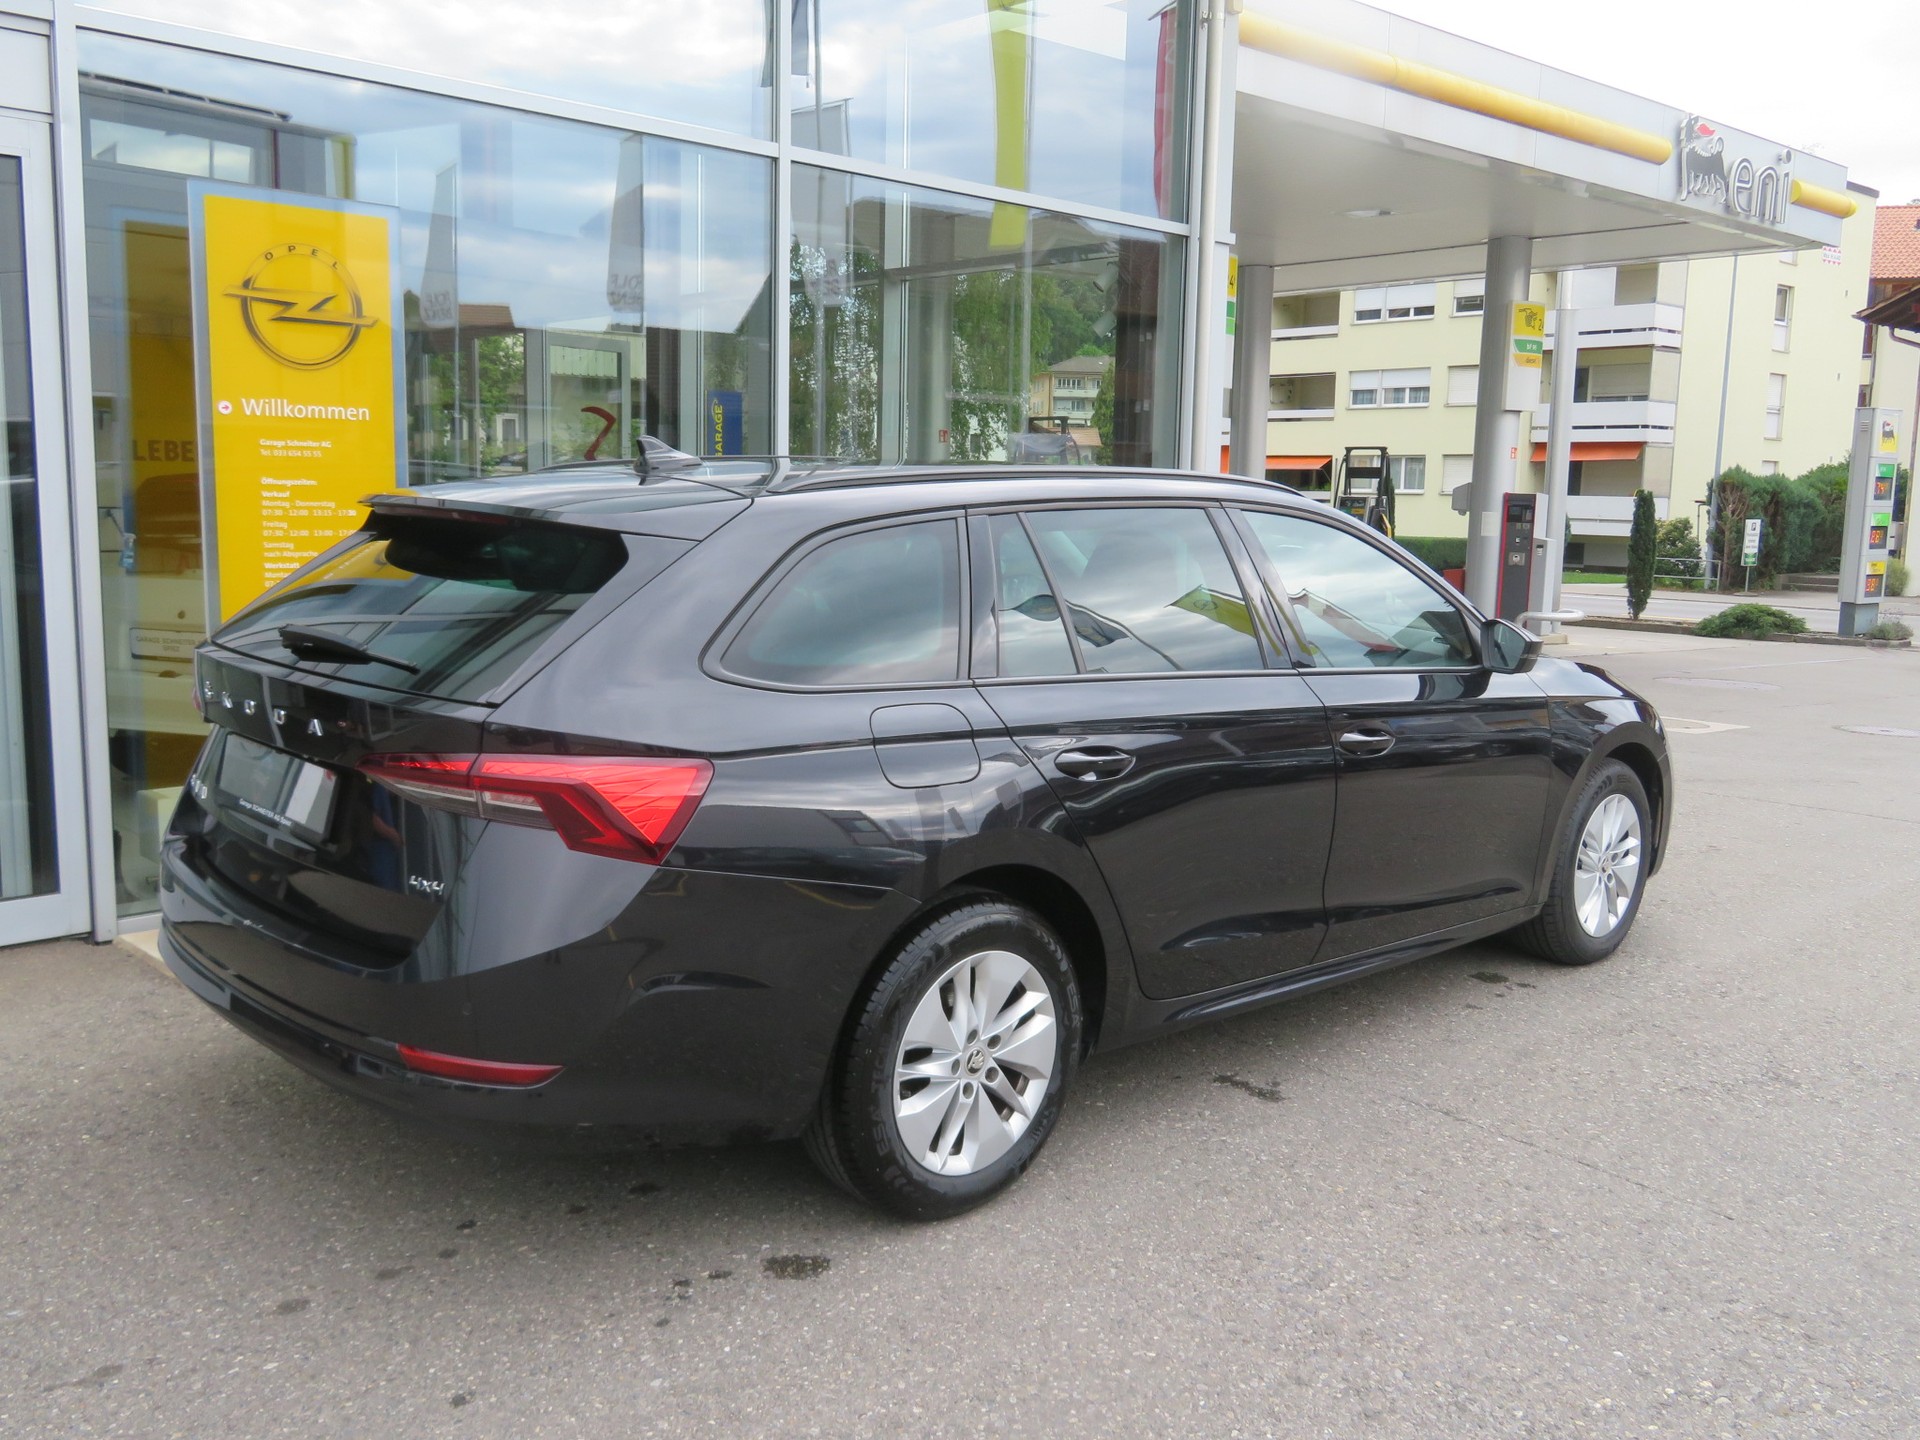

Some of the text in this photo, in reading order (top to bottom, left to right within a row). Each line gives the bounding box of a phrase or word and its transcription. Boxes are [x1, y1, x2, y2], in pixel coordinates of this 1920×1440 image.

[1728, 149, 1792, 225] eni
[264, 244, 341, 270] OPEL
[241, 398, 370, 421] Willkommen
[259, 438, 286, 448] Garage
[287, 440, 320, 448] Schneiter
[313, 450, 322, 458] 55
[262, 500, 290, 509] Montag
[295, 500, 336, 509] Donnerstag
[262, 521, 288, 529] Freitag
[263, 541, 294, 550] Samstag
